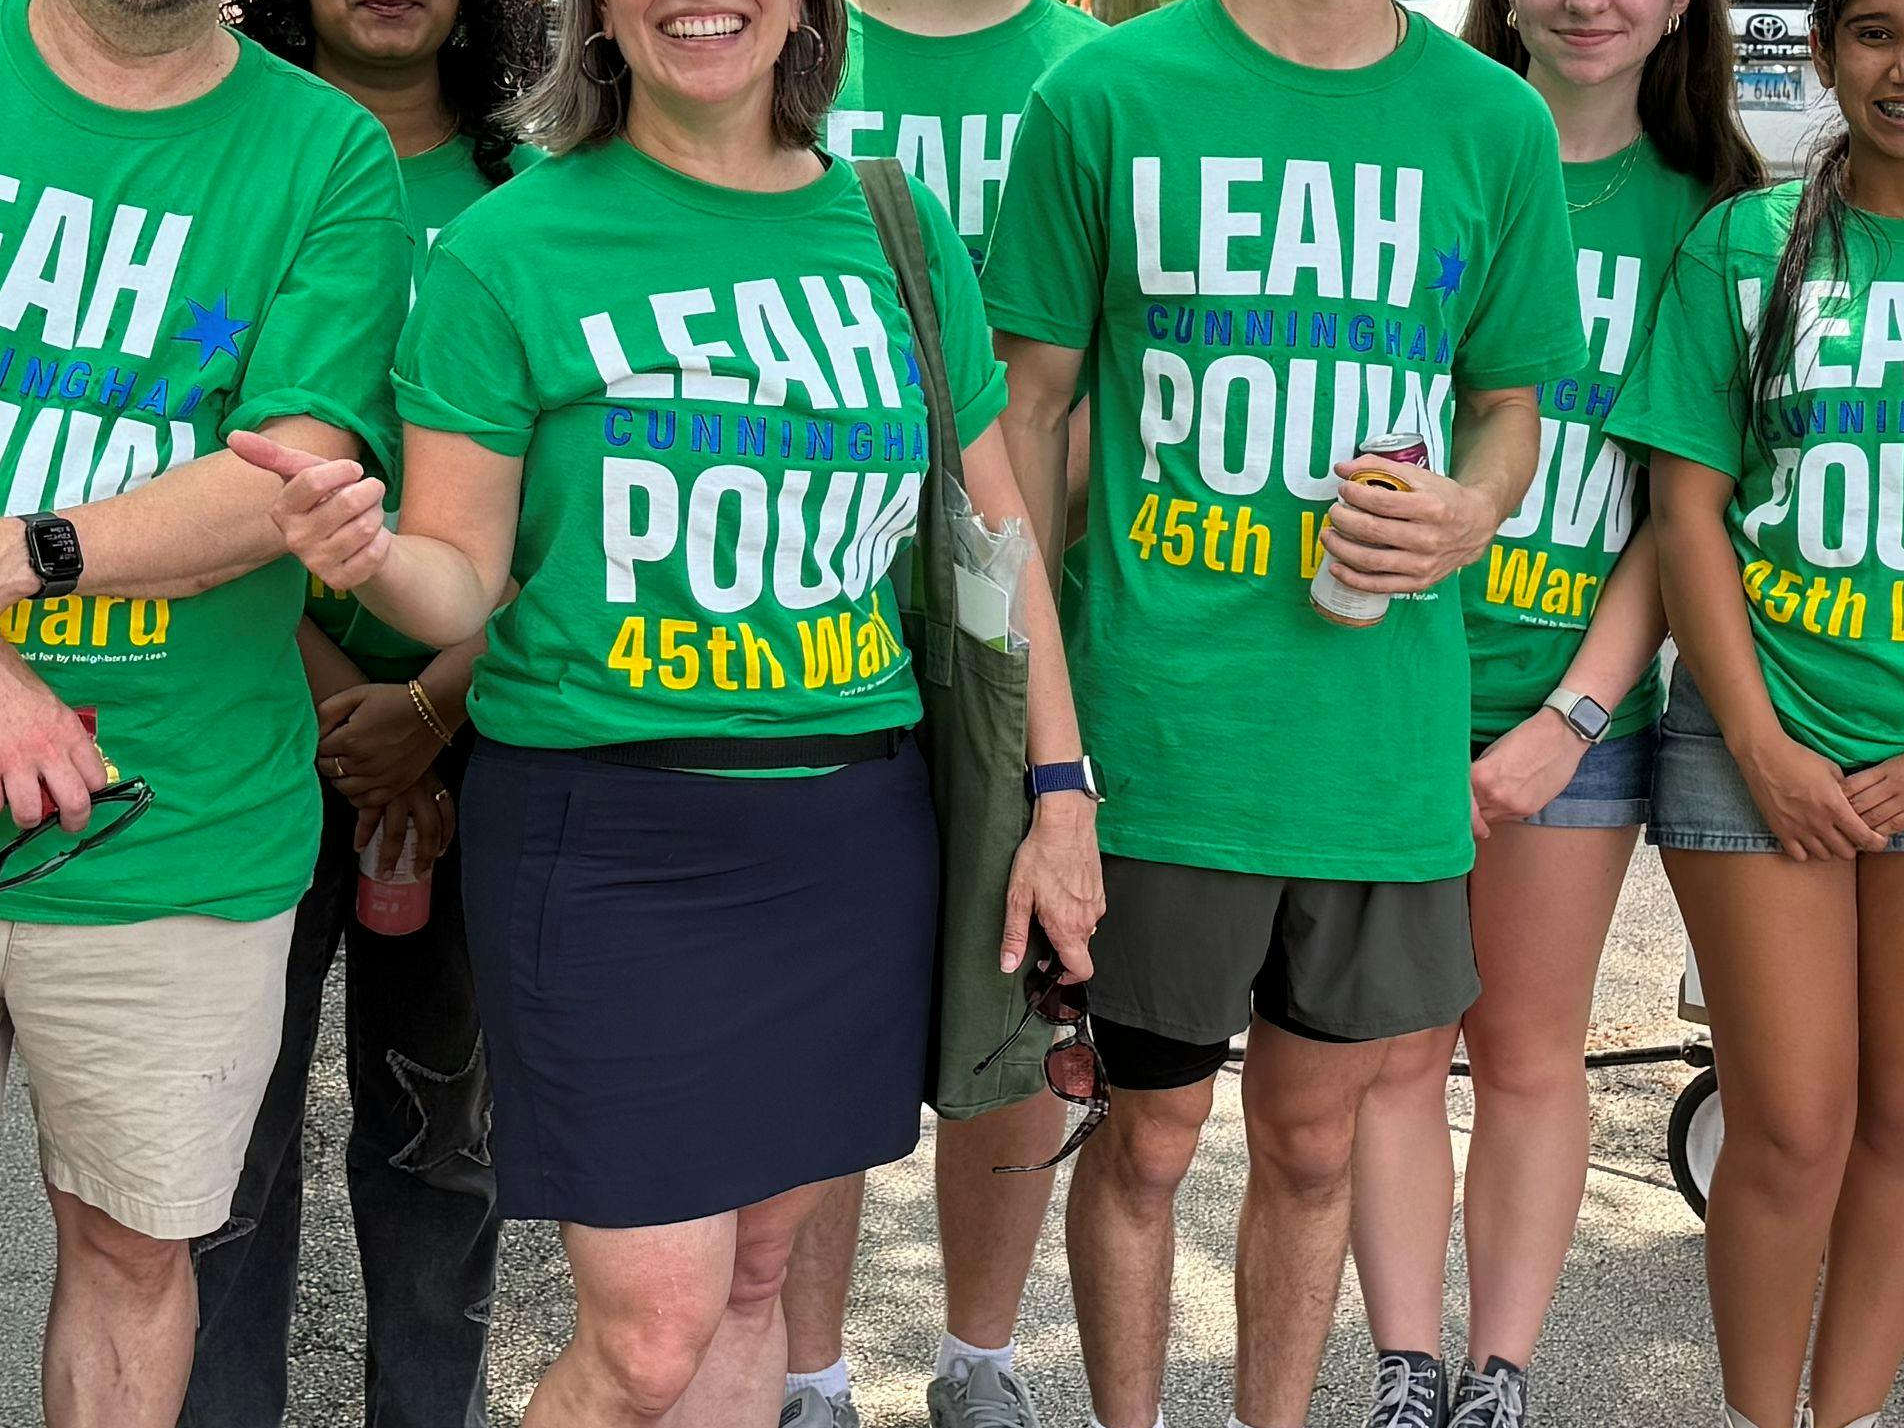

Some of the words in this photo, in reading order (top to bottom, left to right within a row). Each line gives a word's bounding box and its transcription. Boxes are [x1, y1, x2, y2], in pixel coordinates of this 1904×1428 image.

[827, 110, 1022, 236] EAH
[1132, 157, 1423, 308] LEAH
[579, 274, 902, 410] LEAH
[603, 407, 925, 462] CUNNINGHA
[1128, 493, 1270, 576] 45th
[1486, 544, 1607, 619] War
[607, 615, 786, 693] 45th
